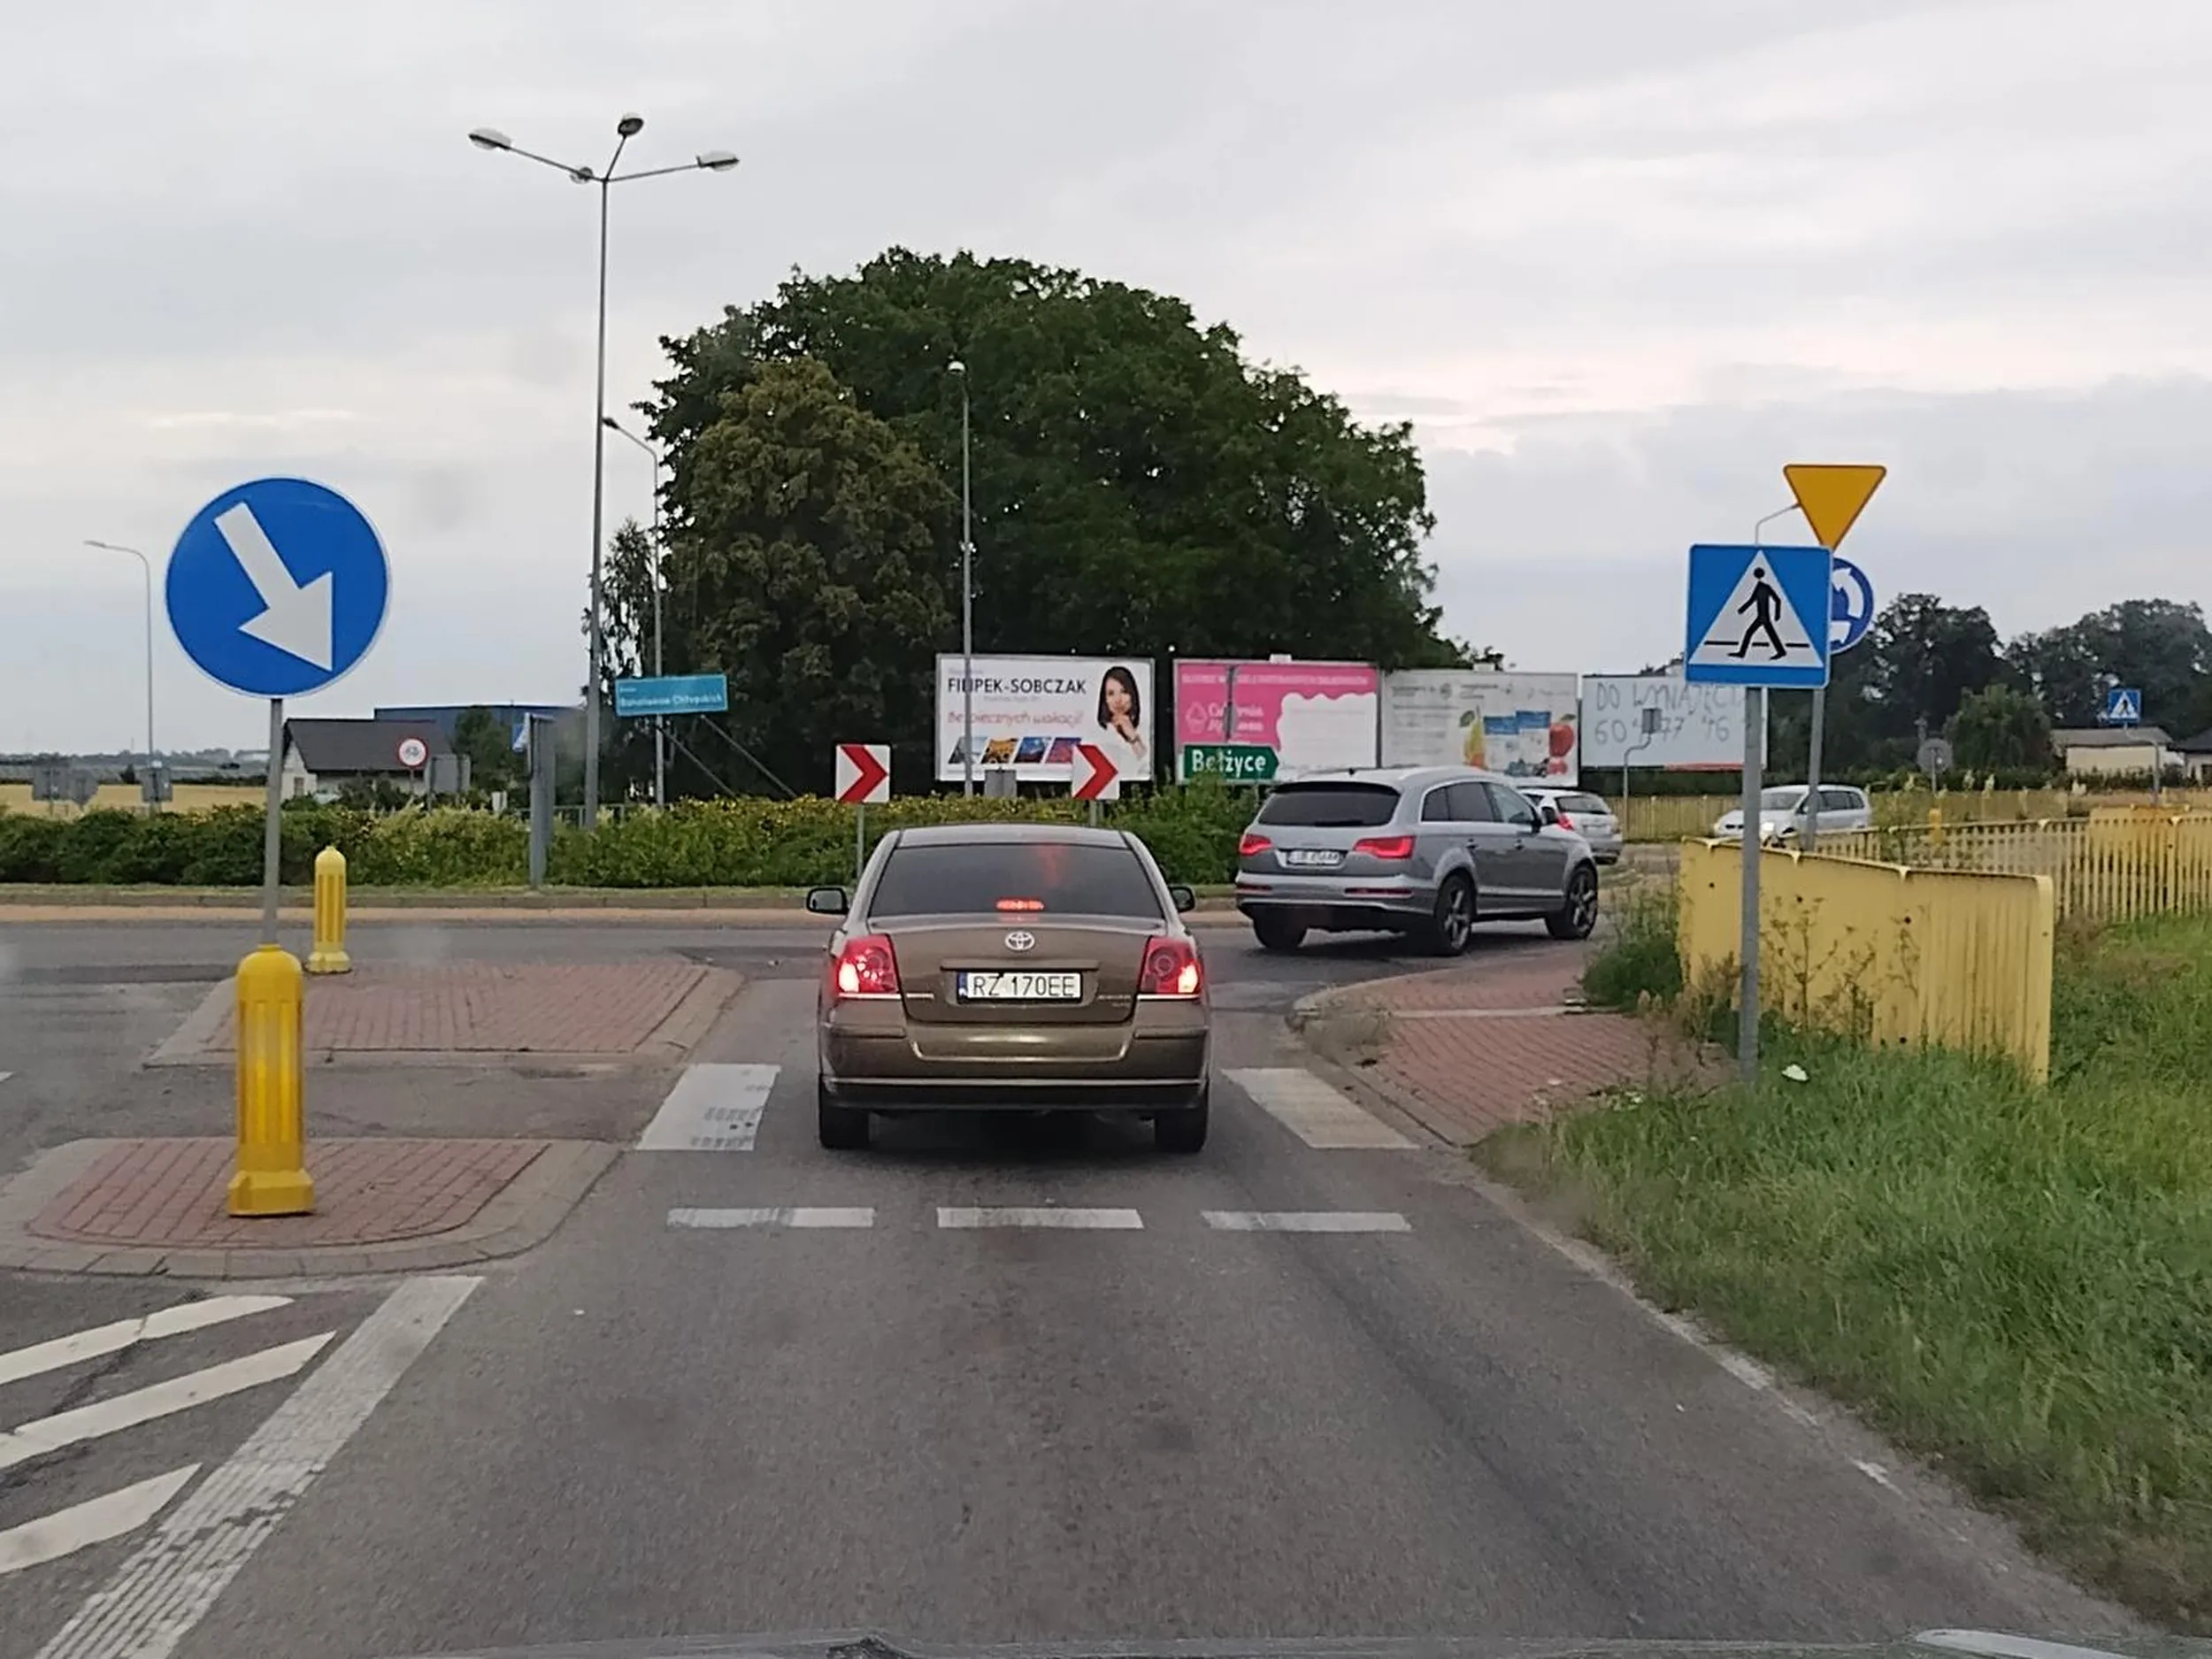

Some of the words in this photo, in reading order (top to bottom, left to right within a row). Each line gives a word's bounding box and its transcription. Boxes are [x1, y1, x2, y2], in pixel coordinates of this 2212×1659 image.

[1596, 682, 1621, 711] DO
[973, 976, 1000, 996] RZ
[1011, 976, 1075, 997] 170EE
